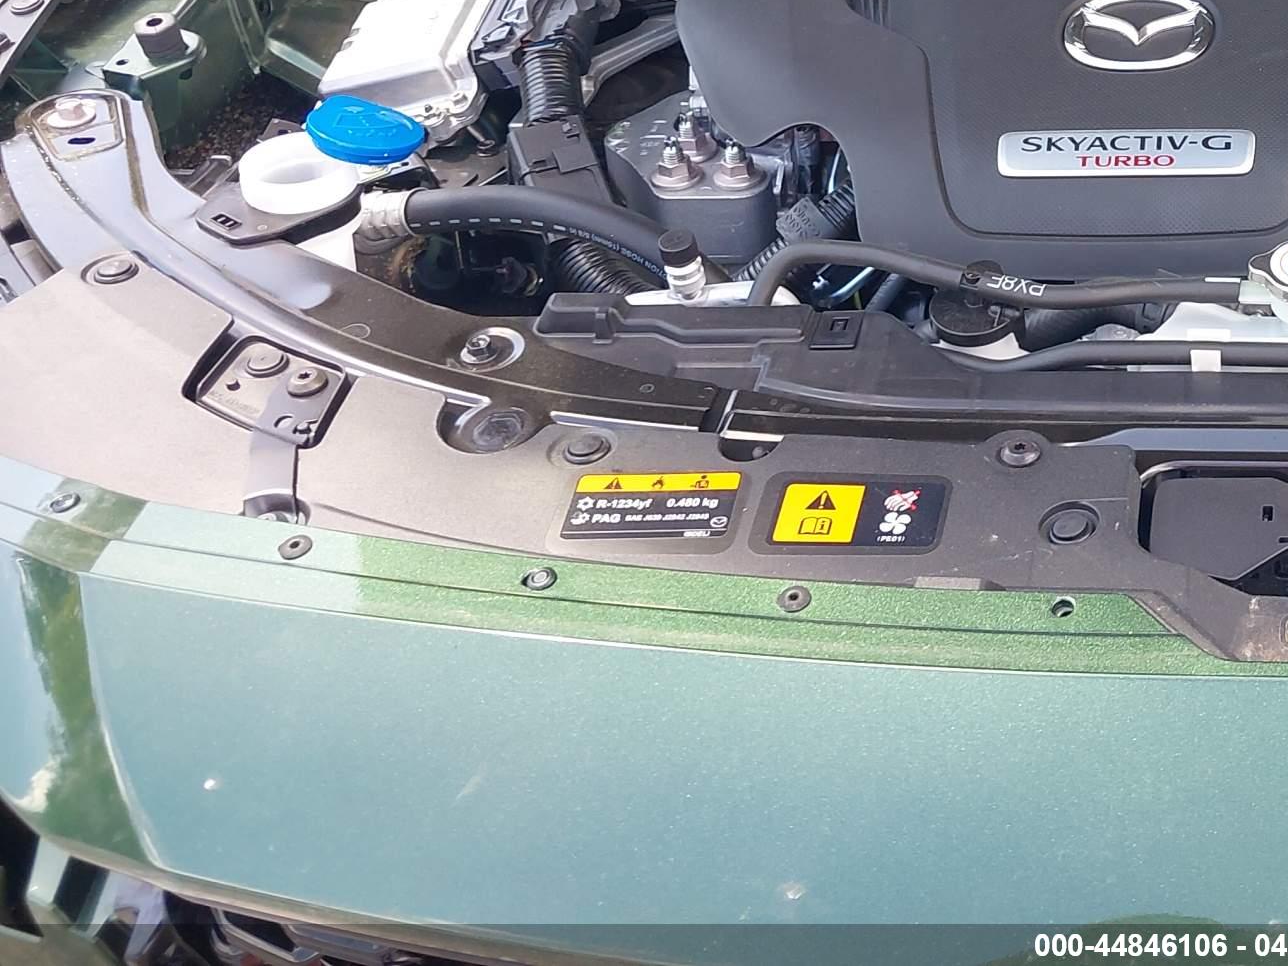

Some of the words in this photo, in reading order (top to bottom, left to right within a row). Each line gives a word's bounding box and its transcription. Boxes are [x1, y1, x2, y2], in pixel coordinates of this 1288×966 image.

[1021, 135, 1232, 152] SKYACTIV-G
[1077, 155, 1175, 167] TURBO
[596, 499, 653, 510] R-1234yf
[702, 498, 719, 509] kg
[592, 514, 621, 523] PAG
